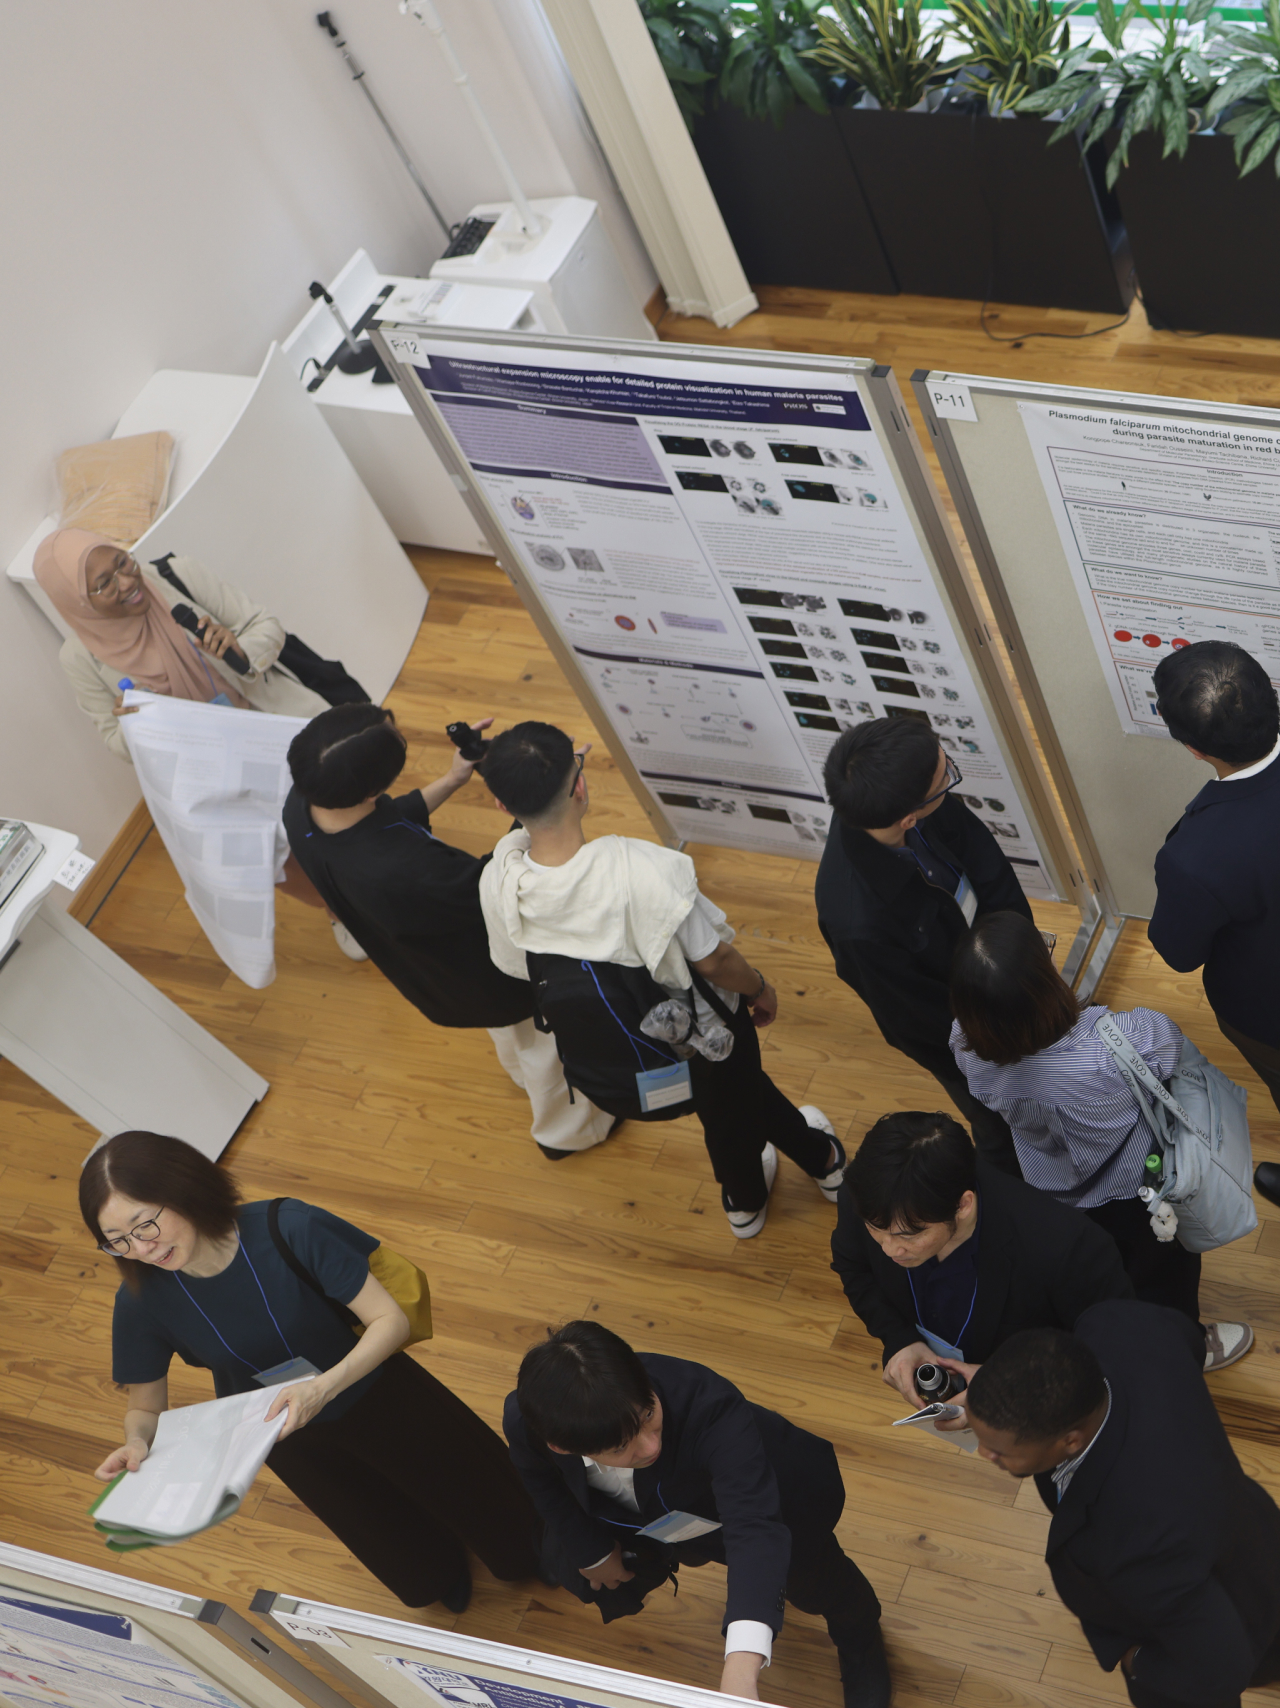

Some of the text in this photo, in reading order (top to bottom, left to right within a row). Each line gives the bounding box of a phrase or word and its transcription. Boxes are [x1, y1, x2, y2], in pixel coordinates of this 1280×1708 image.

[449, 360, 844, 403] Ultrastructural expansion microscopy enable for detailed protein visualization in human malaria parasites
[932, 390, 967, 409] P-11
[1049, 410, 1107, 424] Plasmodium
[1110, 418, 1161, 431] falciparum
[1163, 424, 1231, 440] mitochondrial
[1233, 433, 1274, 445] genome
[1112, 428, 1145, 440] during
[1147, 432, 1186, 444] parasite
[1187, 436, 1242, 450] maturation
[1243, 443, 1252, 452] in
[1255, 444, 1272, 454] red
[1206, 468, 1243, 478] Introduction
[1105, 508, 1126, 517] already
[1127, 511, 1147, 519] know?
[1142, 574, 1163, 582] know?
[1150, 601, 1172, 609] finding
[1102, 1023, 1123, 1048] COVE
[1129, 1055, 1147, 1077] COVE
[1154, 1081, 1171, 1101] COVE
[286, 1620, 333, 1640] P-03
[474, 1678, 565, 1706] Development
